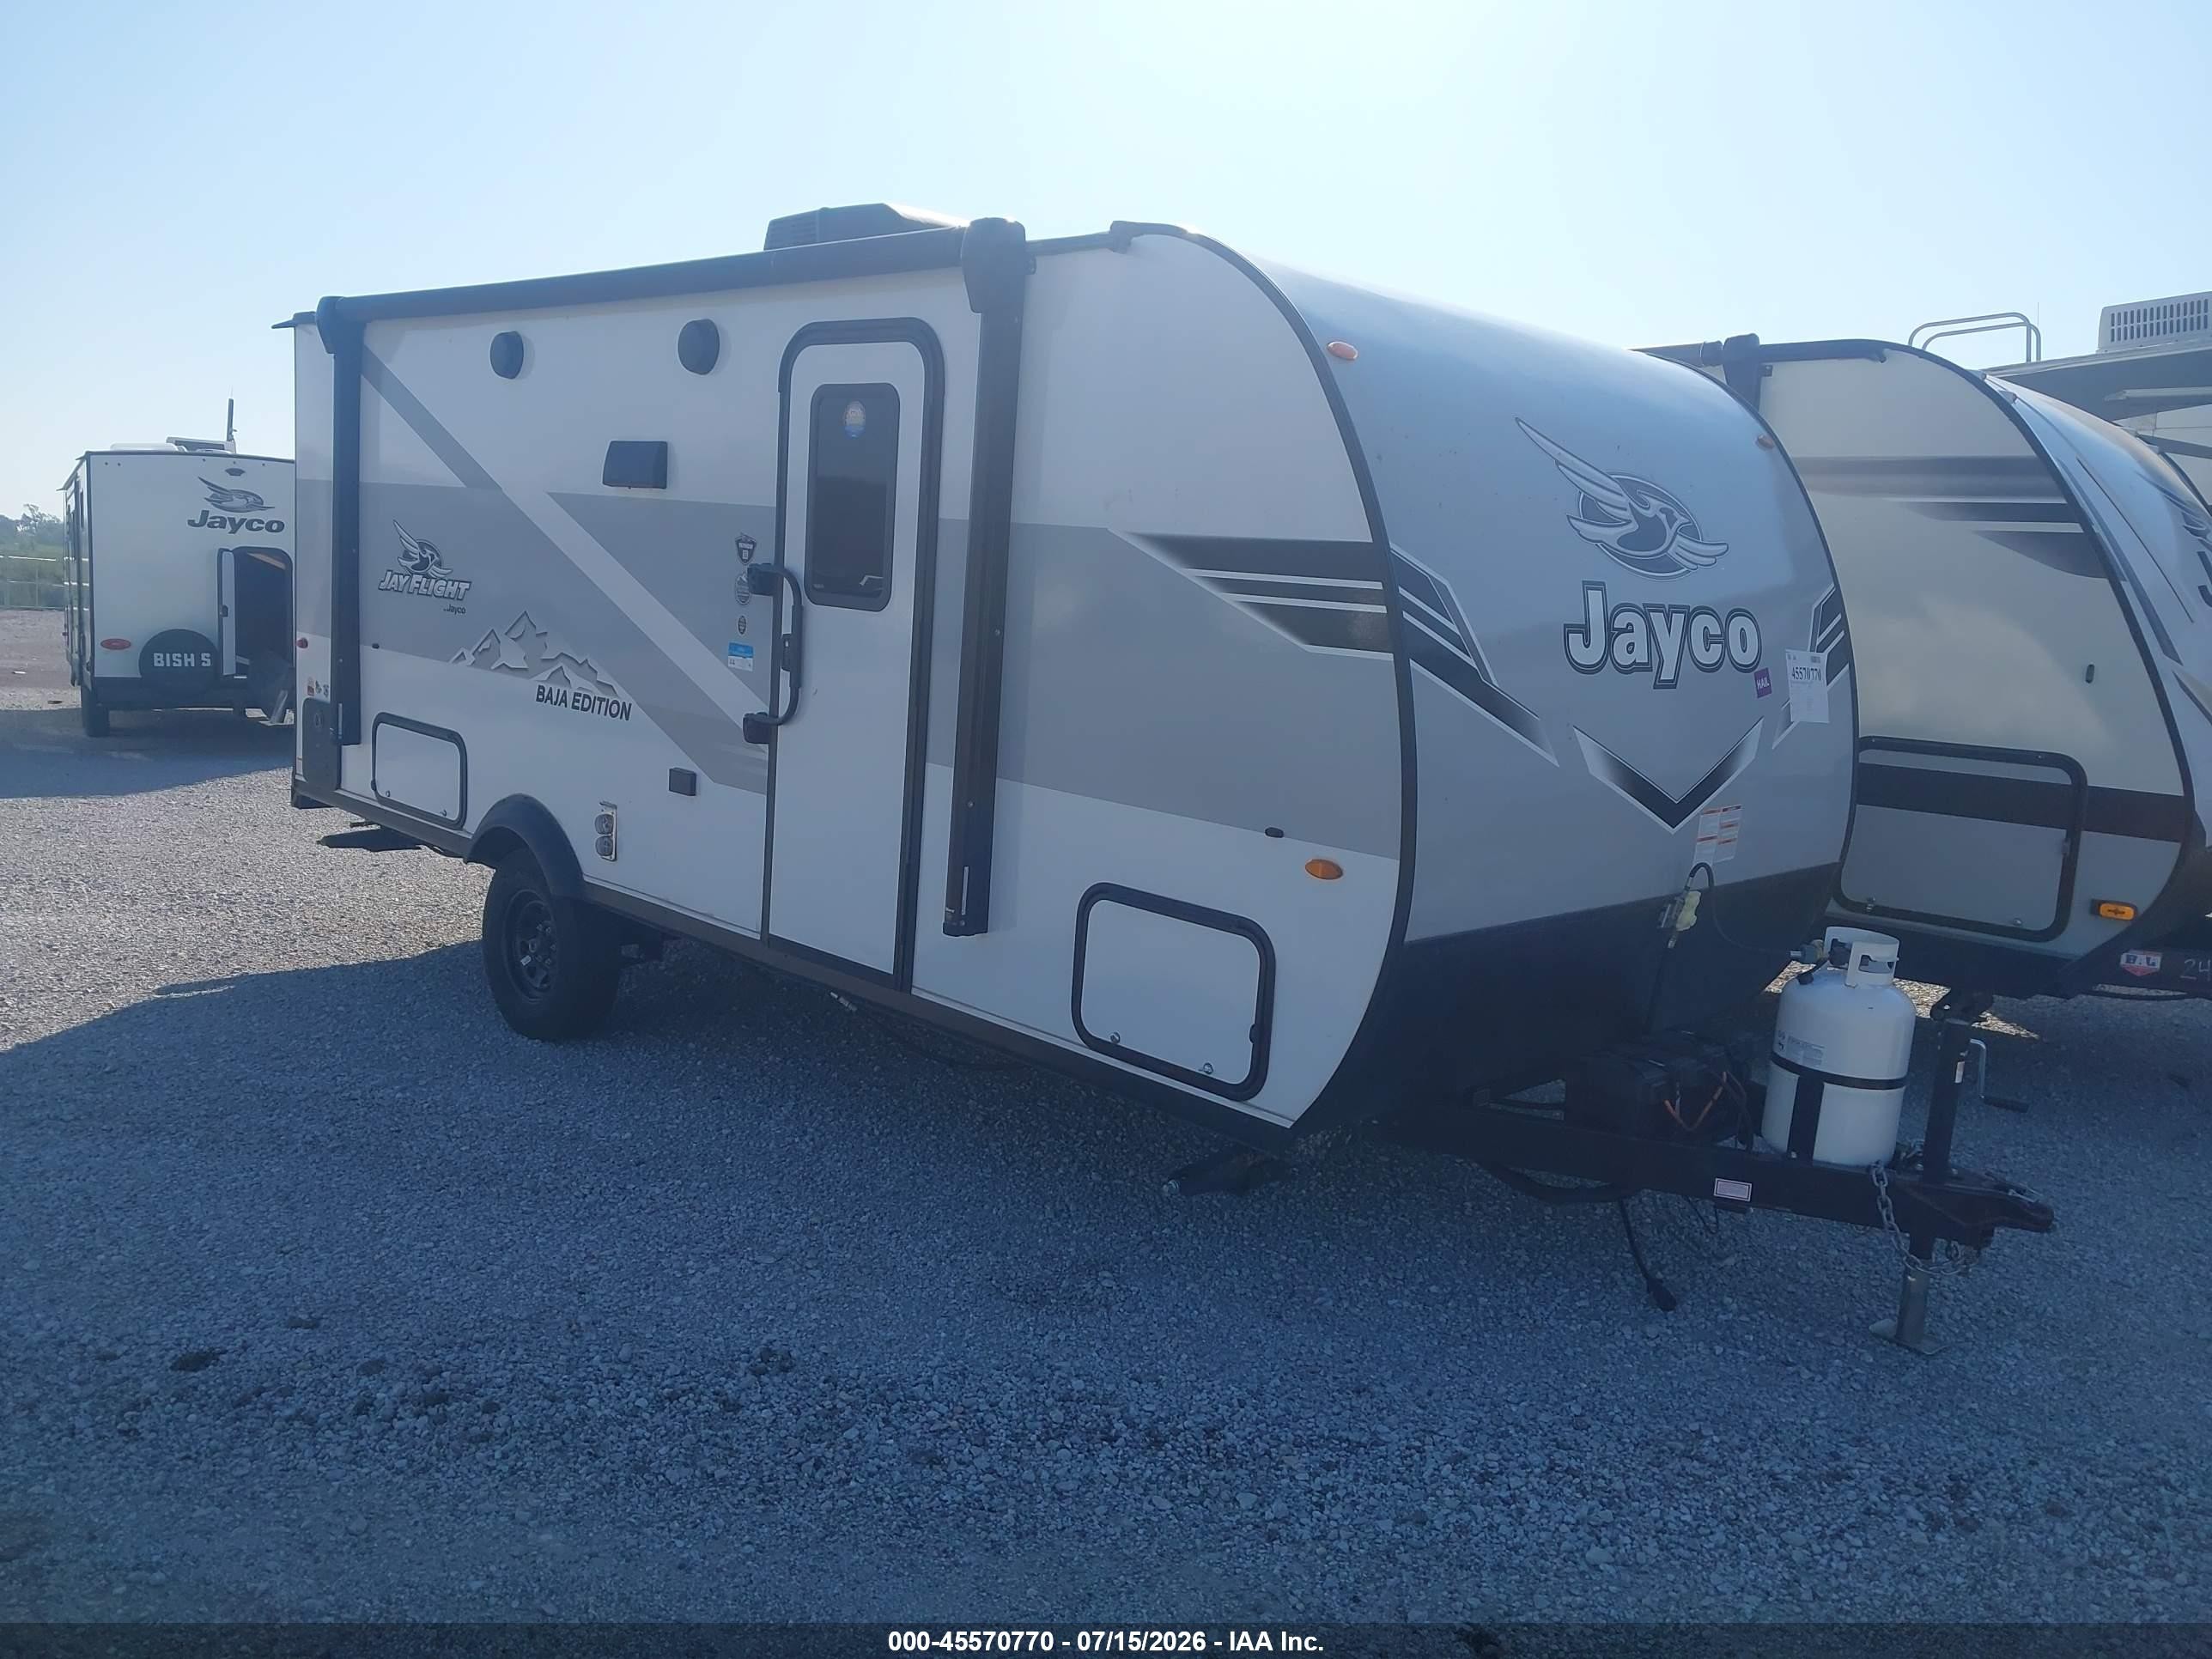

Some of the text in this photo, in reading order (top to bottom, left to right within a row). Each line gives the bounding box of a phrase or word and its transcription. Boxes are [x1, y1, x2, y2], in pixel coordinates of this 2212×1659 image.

[187, 510, 285, 534] Jayco
[378, 570, 471, 601] JAY FLIGHT
[1564, 580, 1762, 690] Jayco
[1756, 676, 1771, 690] HAIL
[1791, 666, 1822, 681] 45570770
[536, 684, 632, 721] BAJA EDITION
